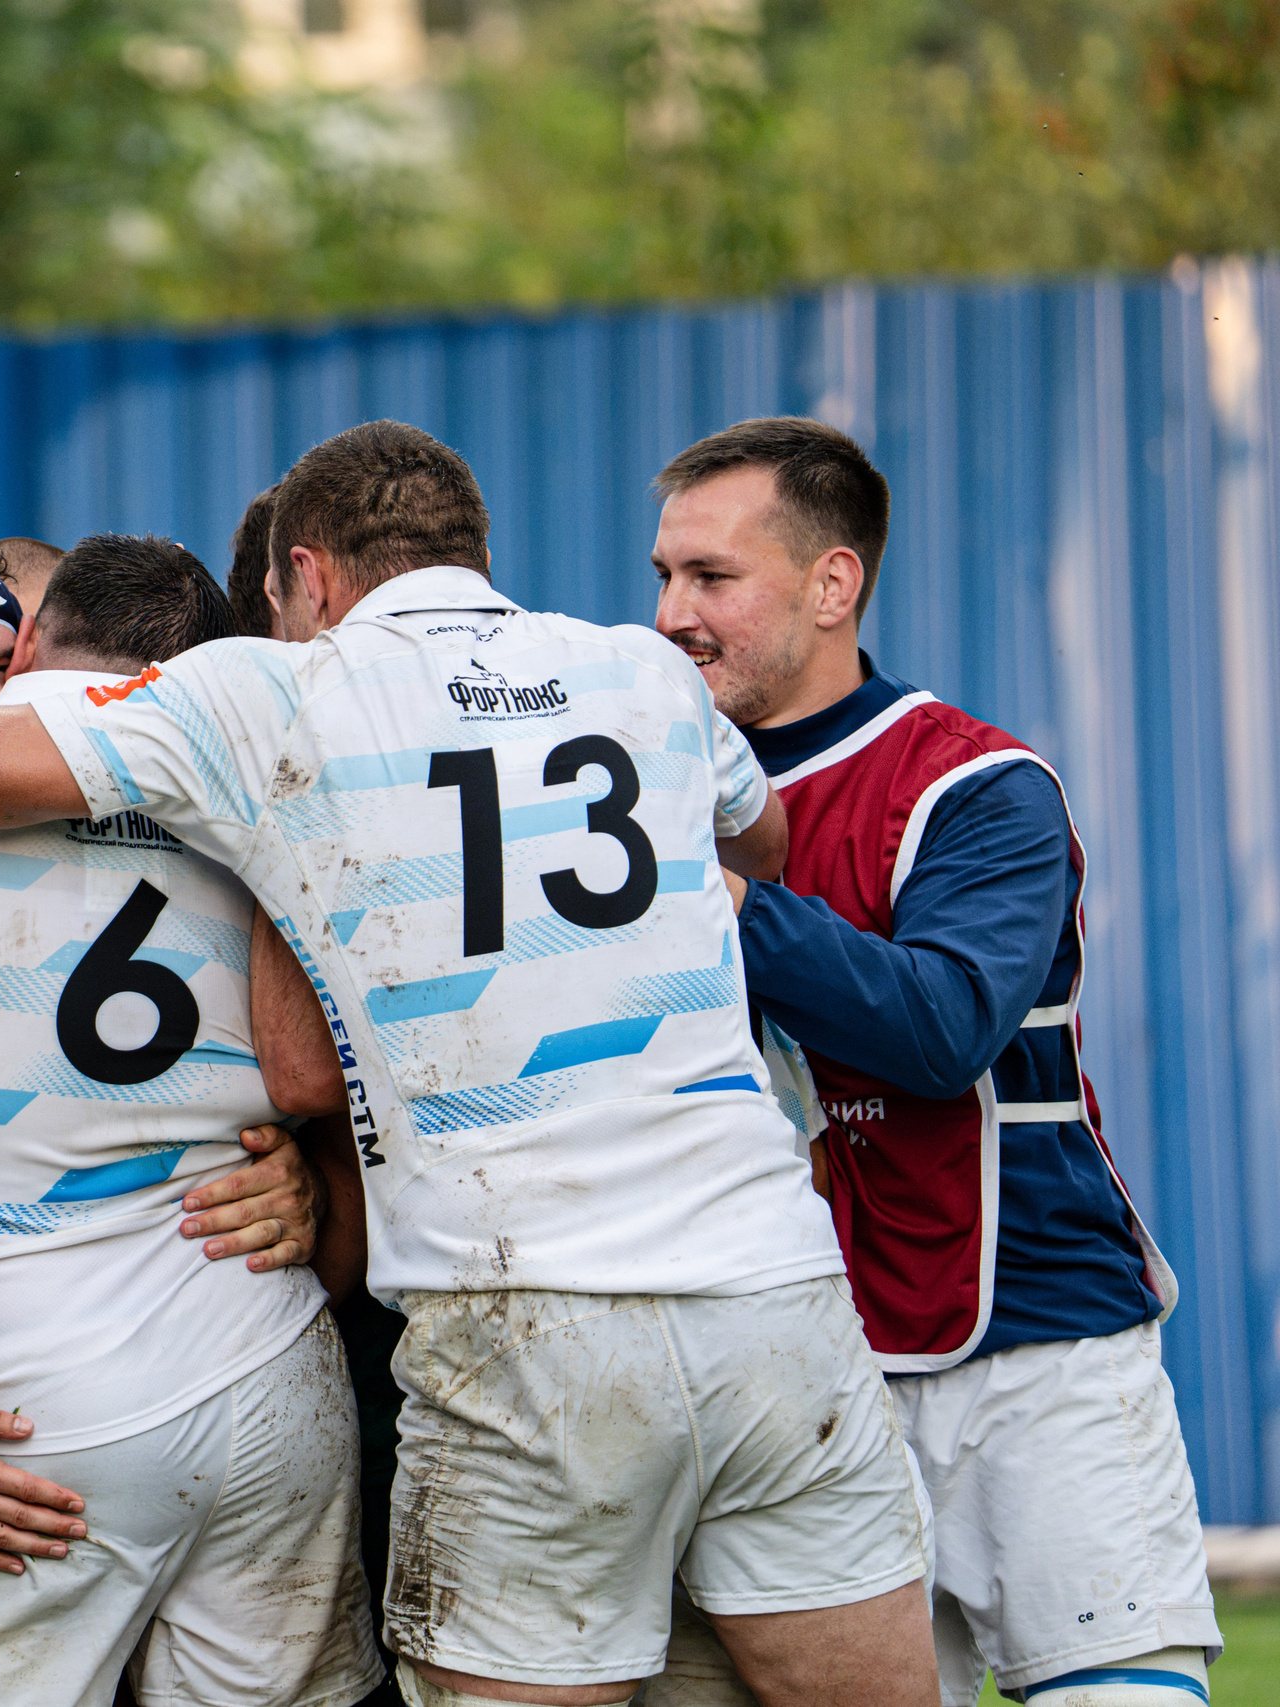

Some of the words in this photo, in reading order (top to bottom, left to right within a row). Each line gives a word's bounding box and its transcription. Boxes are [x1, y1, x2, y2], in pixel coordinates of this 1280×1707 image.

[65, 833, 117, 847] СТРАТЕГИЧЕСКИЙ
[117, 841, 160, 851] ПРОДУКТОВЫЙ
[427, 734, 658, 957] 13
[56, 878, 200, 1085] 6
[346, 1078, 387, 1169] СТМ
